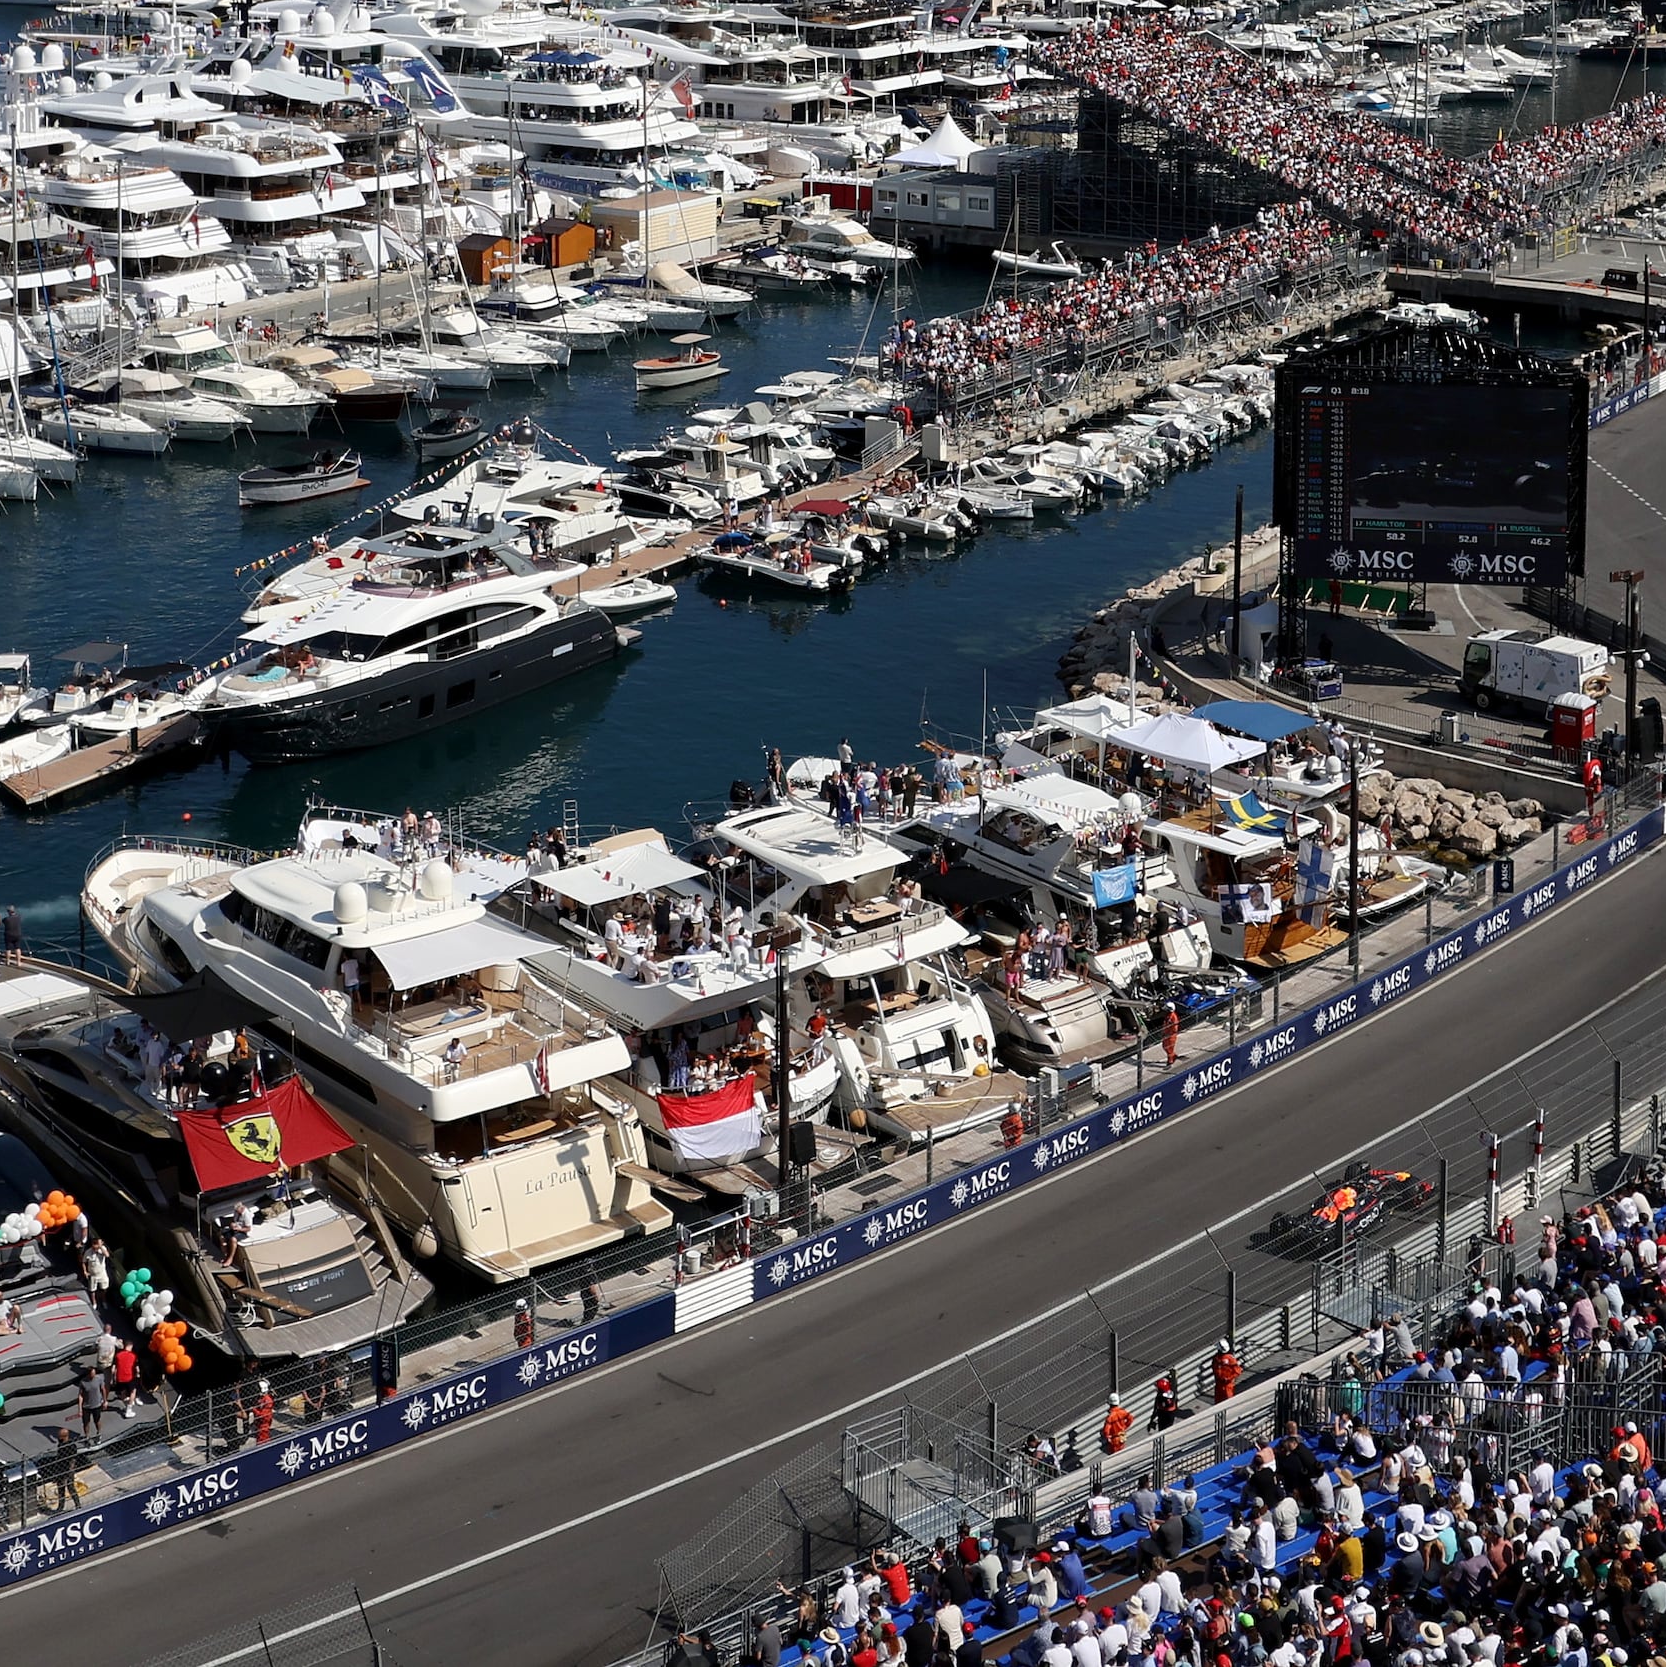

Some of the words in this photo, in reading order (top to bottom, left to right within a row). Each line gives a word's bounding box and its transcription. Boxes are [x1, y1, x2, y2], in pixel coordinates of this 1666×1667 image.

[1365, 520, 1406, 528] HAMILTON
[1358, 550, 1414, 570] MSC
[1479, 554, 1536, 574] MSC
[1357, 571, 1414, 579] CRUISES
[1479, 575, 1536, 583] CRUISES
[1617, 830, 1637, 856] MSC
[1576, 856, 1598, 882] MSC
[1533, 882, 1556, 908] MSC
[1486, 909, 1511, 936] MSC
[1437, 936, 1463, 964] MSC
[1383, 965, 1411, 994] MSC
[1328, 994, 1357, 1024] MSC
[1264, 1026, 1297, 1056] MSC
[1199, 1058, 1232, 1088] MSC
[1127, 1092, 1163, 1124] MSC
[1052, 1126, 1090, 1158] MSC
[525, 1179, 543, 1195] La
[970, 1162, 1011, 1194] MSC
[885, 1198, 928, 1232] MSC
[885, 1220, 928, 1242] CRUISES
[792, 1237, 838, 1272] MSC
[793, 1258, 838, 1282] CRUISES
[545, 1332, 598, 1371] MSC
[545, 1356, 598, 1381] CRUISES
[431, 1375, 487, 1414] MSC
[432, 1398, 487, 1424] CRUISES
[309, 1420, 368, 1460] MSC
[310, 1443, 368, 1470] CRUISES
[177, 1466, 239, 1508] MSC
[177, 1490, 239, 1518] CRUISES
[37, 1514, 105, 1557] MSC
[37, 1540, 105, 1568] CRUISES
